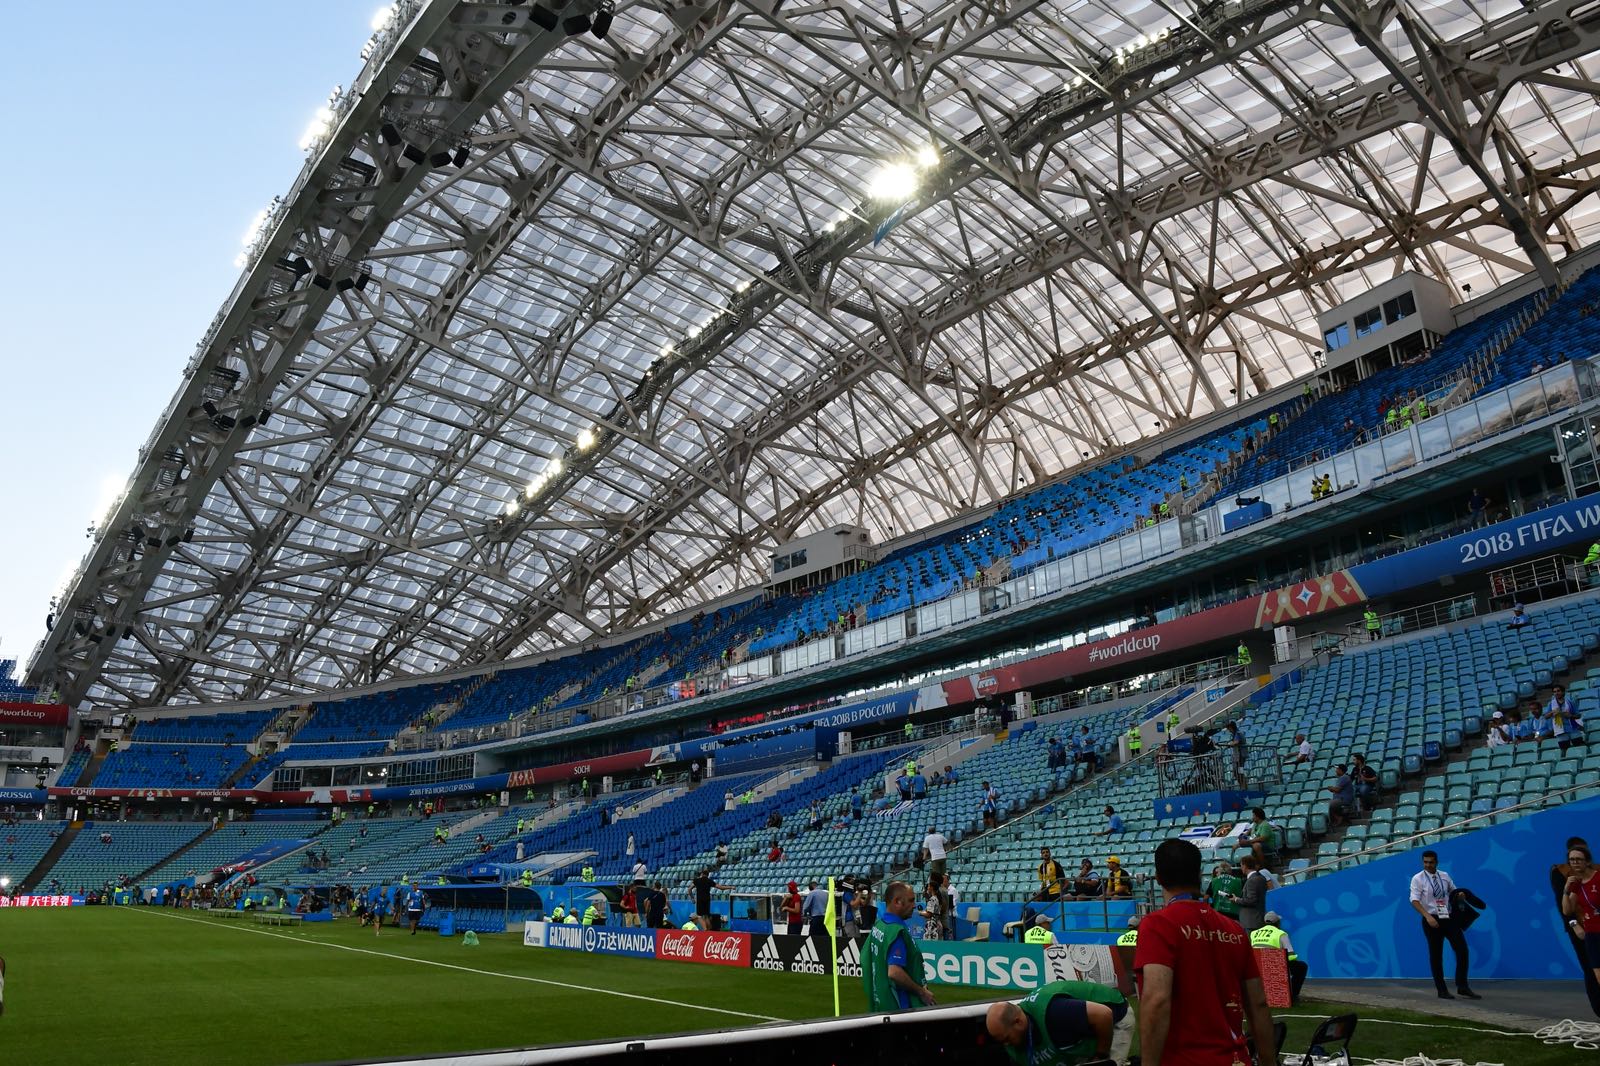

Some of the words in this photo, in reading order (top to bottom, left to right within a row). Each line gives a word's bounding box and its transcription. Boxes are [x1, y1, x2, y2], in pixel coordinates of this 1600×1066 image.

[1460, 532, 1514, 564] 2018
[1516, 514, 1574, 546] FIFA
[1088, 634, 1162, 663] #worldcup
[831, 712, 850, 726] 2018
[859, 701, 896, 720] РОССИИ
[573, 764, 591, 775] SOCHI
[0, 791, 33, 799] RUSSIA
[70, 787, 96, 796] СОЧИ
[549, 926, 582, 949] GAZPROM
[597, 932, 617, 950] 万达
[617, 933, 655, 952] WANDA
[754, 957, 784, 971] adidas
[791, 961, 825, 975] adidas
[836, 963, 863, 977] adida
[921, 952, 1038, 988] sense
